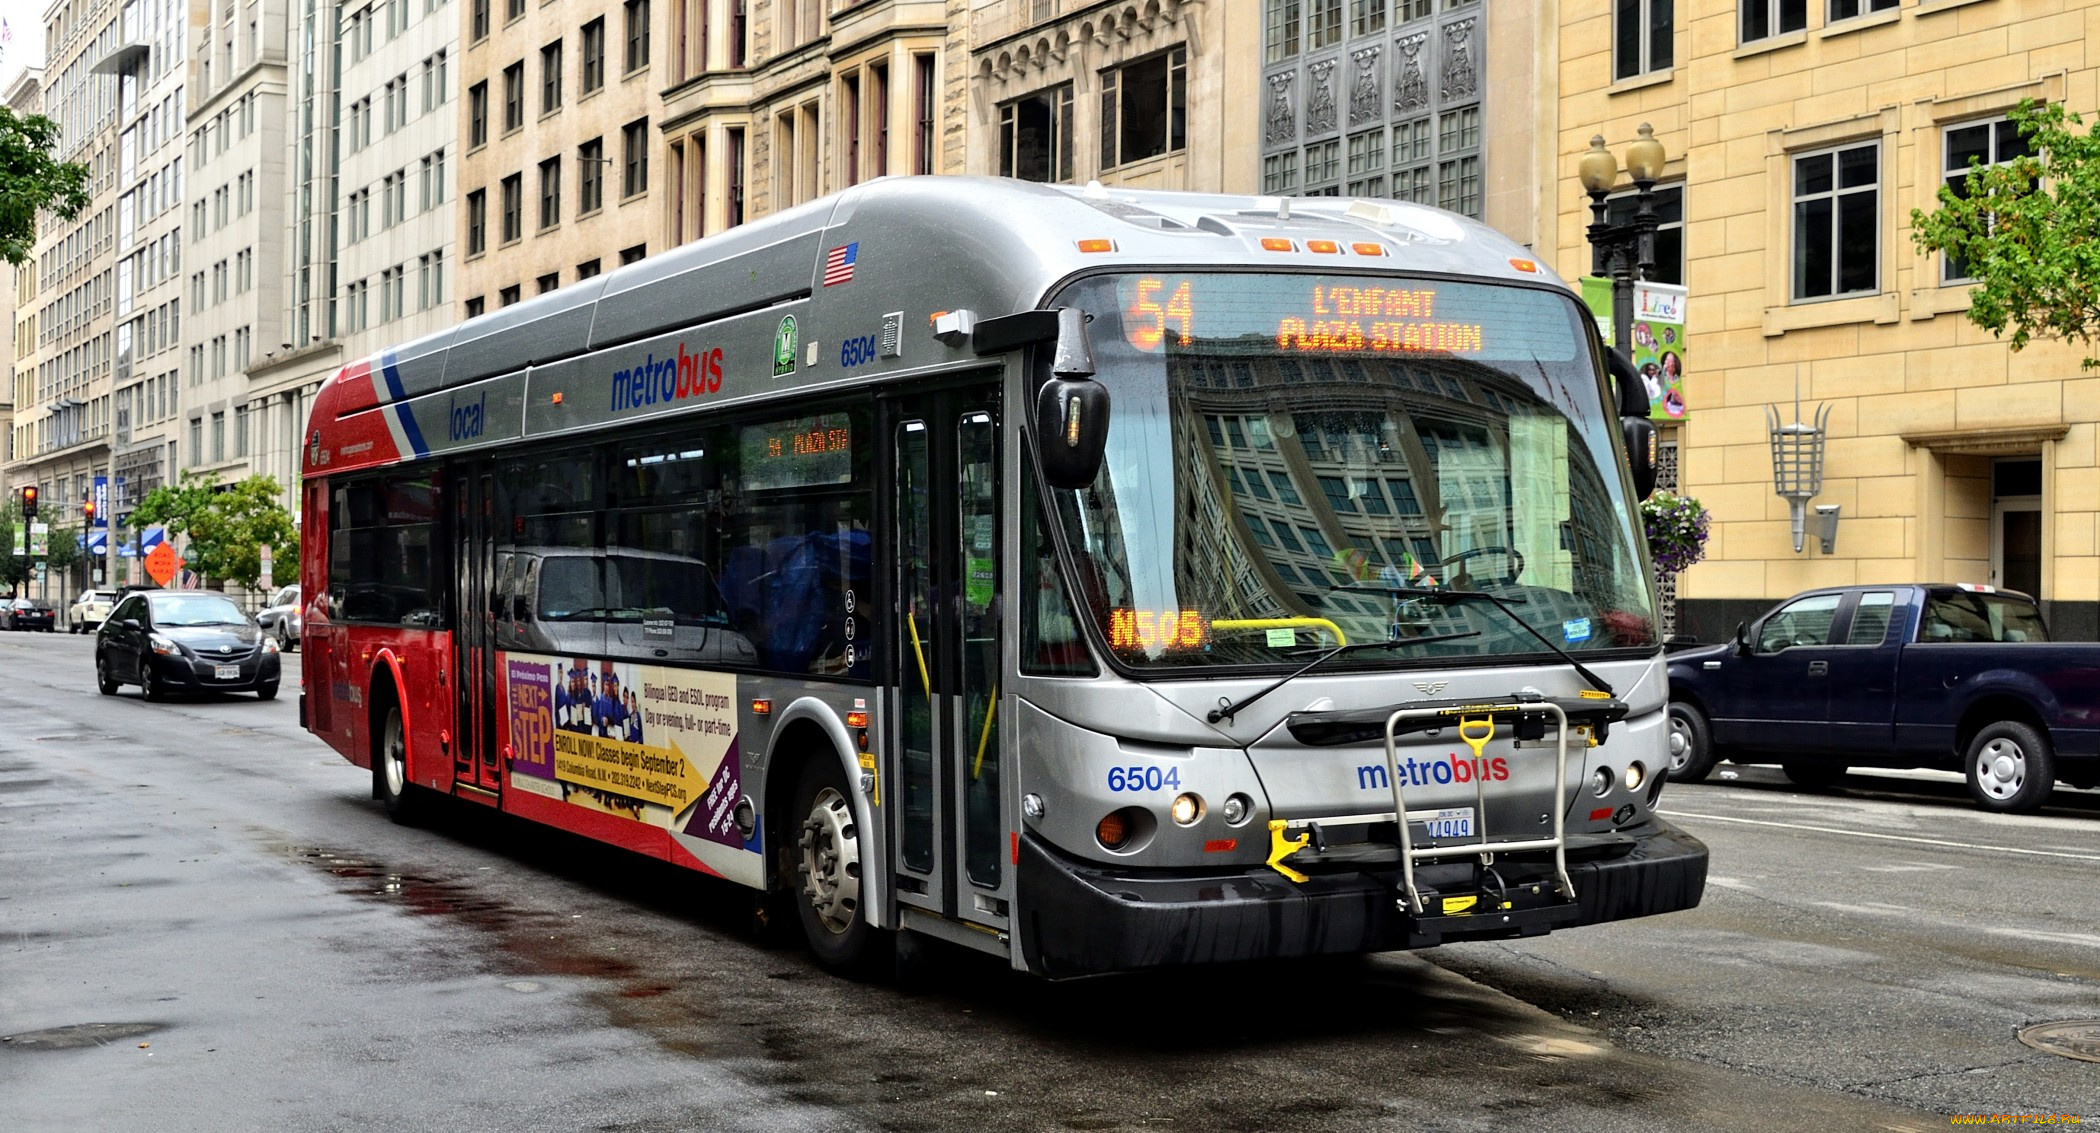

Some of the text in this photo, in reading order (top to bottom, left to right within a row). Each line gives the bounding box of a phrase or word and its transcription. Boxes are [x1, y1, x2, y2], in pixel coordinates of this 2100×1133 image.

[1138, 279, 1193, 344] 54
[1313, 287, 1436, 317] L'ENFANT
[841, 334, 876, 368] 6504
[1279, 318, 1482, 351] PLAZA STATION
[611, 343, 723, 412] metrobus
[449, 391, 486, 441] local
[769, 438, 781, 457] 54
[794, 432, 826, 455] PLAZA
[1113, 611, 1201, 646] N505
[518, 683, 538, 710] NEXT
[644, 683, 730, 712] Bilingual GED and ESOL program
[513, 705, 552, 765] STEP
[645, 708, 731, 737] Day or evening, full- or part-time
[555, 733, 685, 778] ENROLL NOW! Classes begin September 2
[1357, 753, 1509, 790] metrobus
[566, 761, 585, 777] Columbia
[585, 765, 596, 780] Road,
[646, 778, 687, 804] NextStepPCS.org
[707, 787, 719, 811] FREE
[716, 778, 724, 795] for
[1107, 766, 1181, 792] 6504
[708, 779, 738, 833] residents ages
